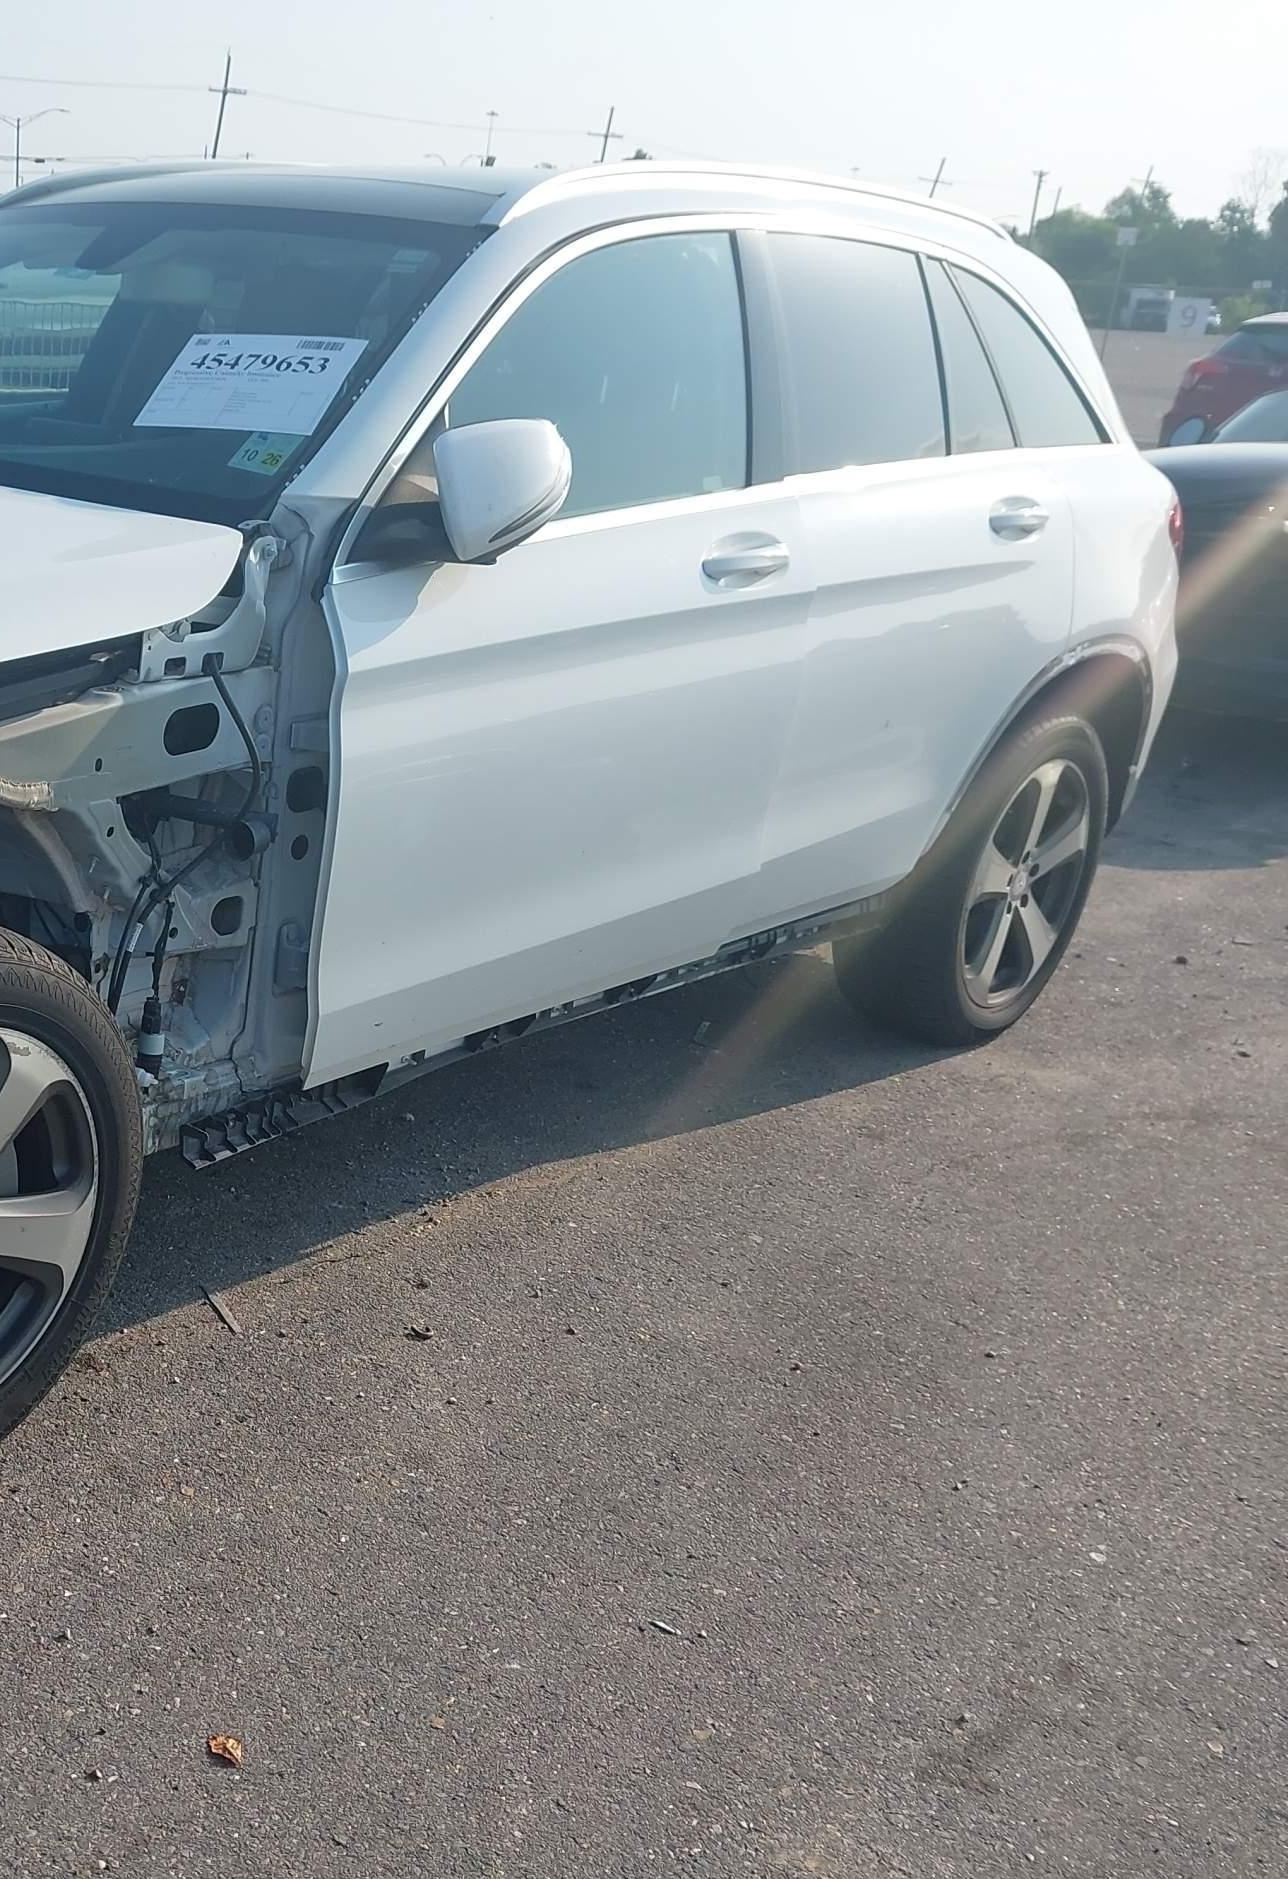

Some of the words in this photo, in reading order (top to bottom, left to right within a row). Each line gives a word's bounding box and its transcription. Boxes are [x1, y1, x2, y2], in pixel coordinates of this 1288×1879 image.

[1180, 304, 1197, 328] 9
[190, 353, 330, 374] 45479653
[242, 449, 259, 462] 10
